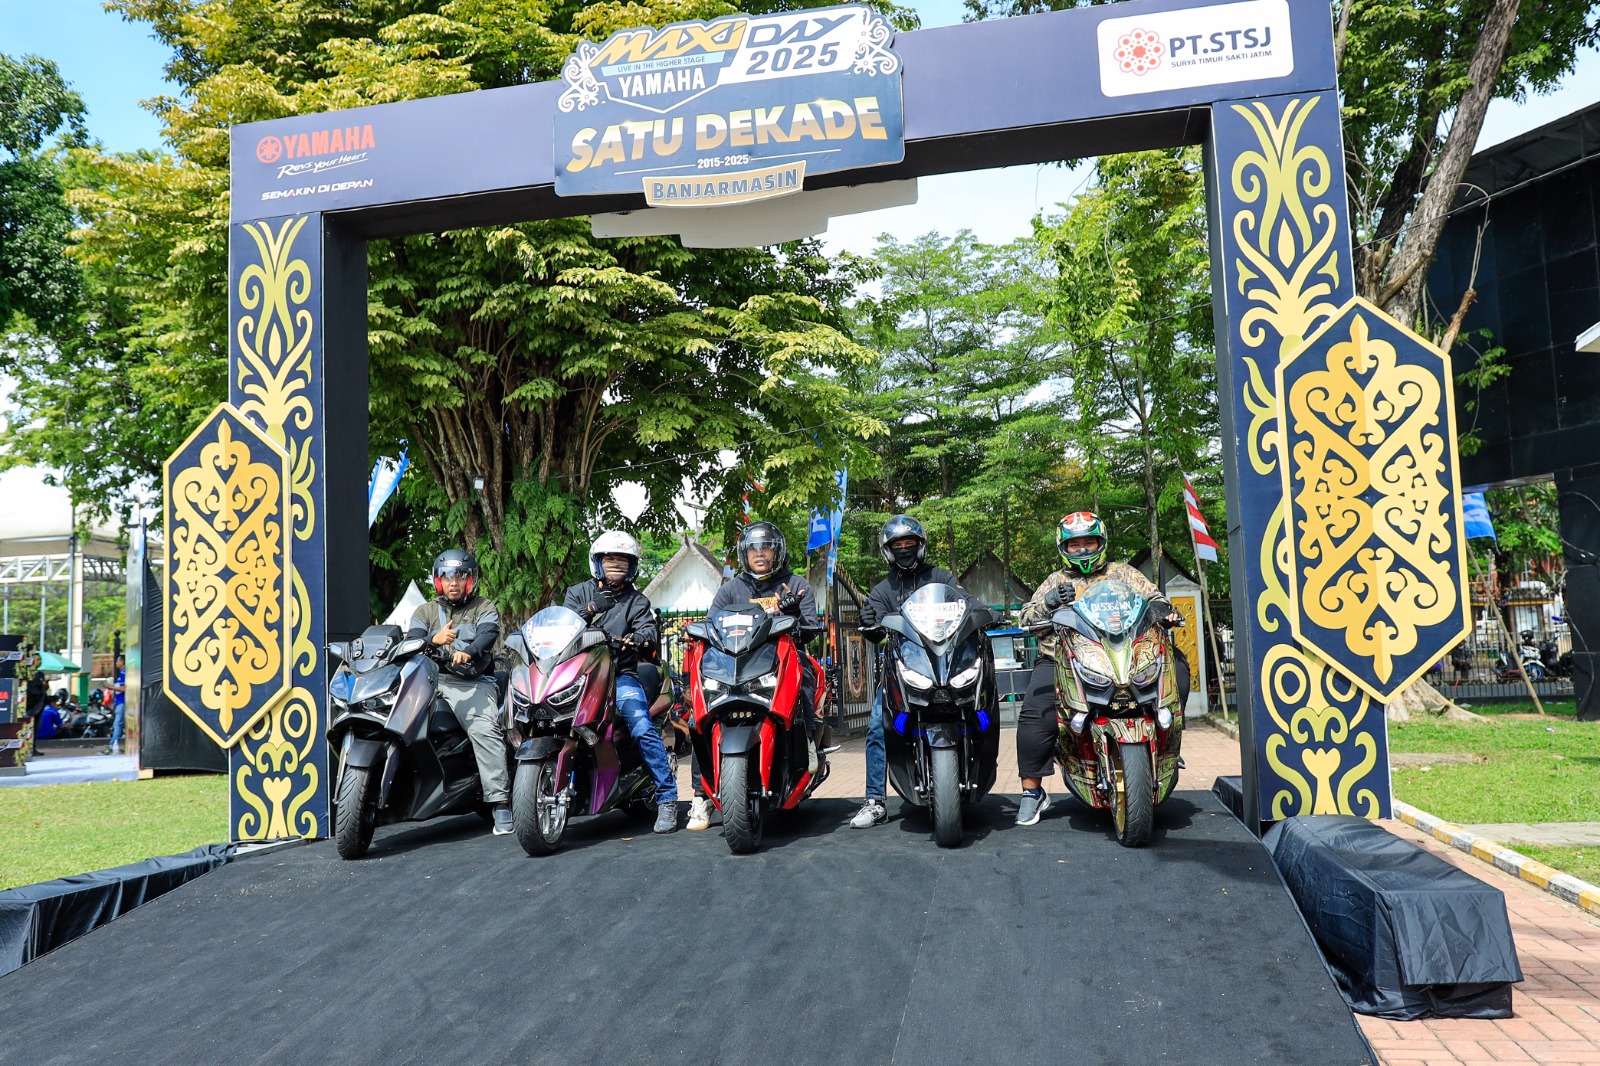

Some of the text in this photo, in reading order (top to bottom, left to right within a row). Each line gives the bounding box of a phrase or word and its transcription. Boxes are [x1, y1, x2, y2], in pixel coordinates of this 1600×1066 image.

[589, 14, 857, 67] MAXI DAY
[1169, 26, 1271, 58] PT.STSJ
[617, 65, 632, 73] LIVE
[643, 62, 654, 70] THE
[656, 59, 682, 67] HIGHER
[683, 56, 705, 64] STAGE
[746, 41, 839, 76] 2025
[1171, 50, 1272, 68] SURYA TIMUR SAKTI JATIM
[618, 67, 706, 98] YAMAHA
[283, 124, 376, 159] YAMAHA
[565, 96, 889, 173] SATU DEKADE
[277, 152, 368, 179] Revs your Heart
[697, 154, 750, 169] 2015-2025
[261, 178, 374, 201] SEMAKIN DI DEPAN
[652, 168, 799, 200] BANJARMASIN
